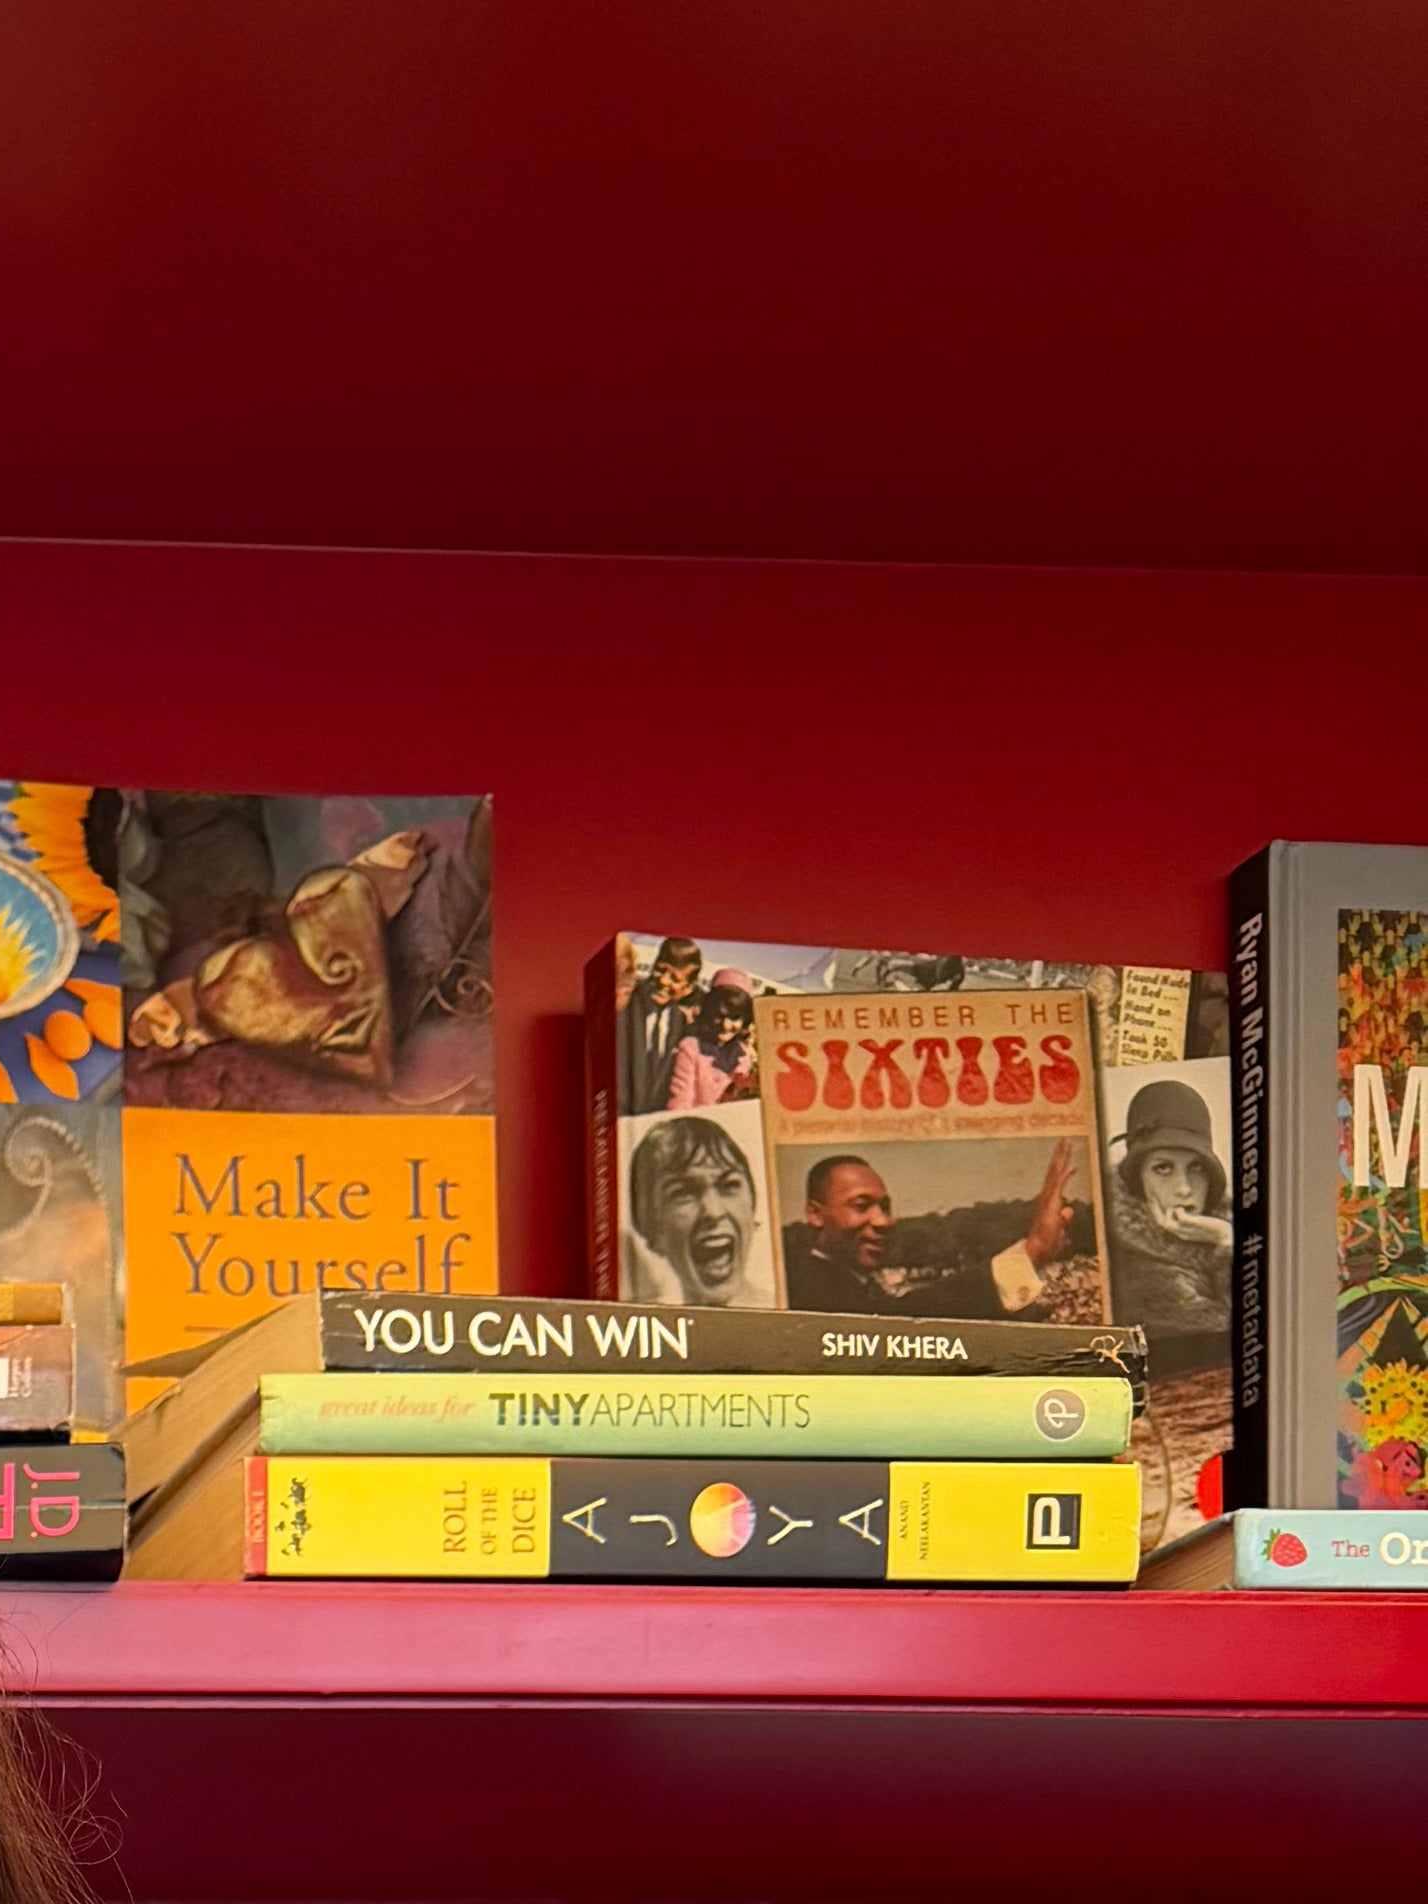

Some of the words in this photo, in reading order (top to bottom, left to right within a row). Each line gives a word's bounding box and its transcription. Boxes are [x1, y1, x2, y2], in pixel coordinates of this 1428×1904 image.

[1235, 912, 1263, 1004] Ryan
[773, 1005, 976, 1032] REMEMBER
[1008, 1002, 1074, 1026] THE
[775, 1035, 1082, 1111] SIXTIES
[1237, 1008, 1263, 1209] McGinness
[172, 1153, 374, 1223] Make
[405, 1157, 460, 1221] It
[171, 1231, 471, 1298] Yourself
[354, 1309, 455, 1355] YOU
[467, 1311, 575, 1358] CAN
[586, 1314, 689, 1361] WIN
[821, 1332, 880, 1358] SHIV
[886, 1334, 969, 1361] KHERA
[1240, 1233, 1263, 1408] #metadata
[381, 1395, 438, 1418] ideas
[437, 1397, 476, 1424] for
[443, 1480, 469, 1554] ROLL
[479, 1486, 499, 1529] THE
[512, 1486, 537, 1555] DICE
[479, 1531, 497, 1555] OF
[1330, 1538, 1371, 1560] The
